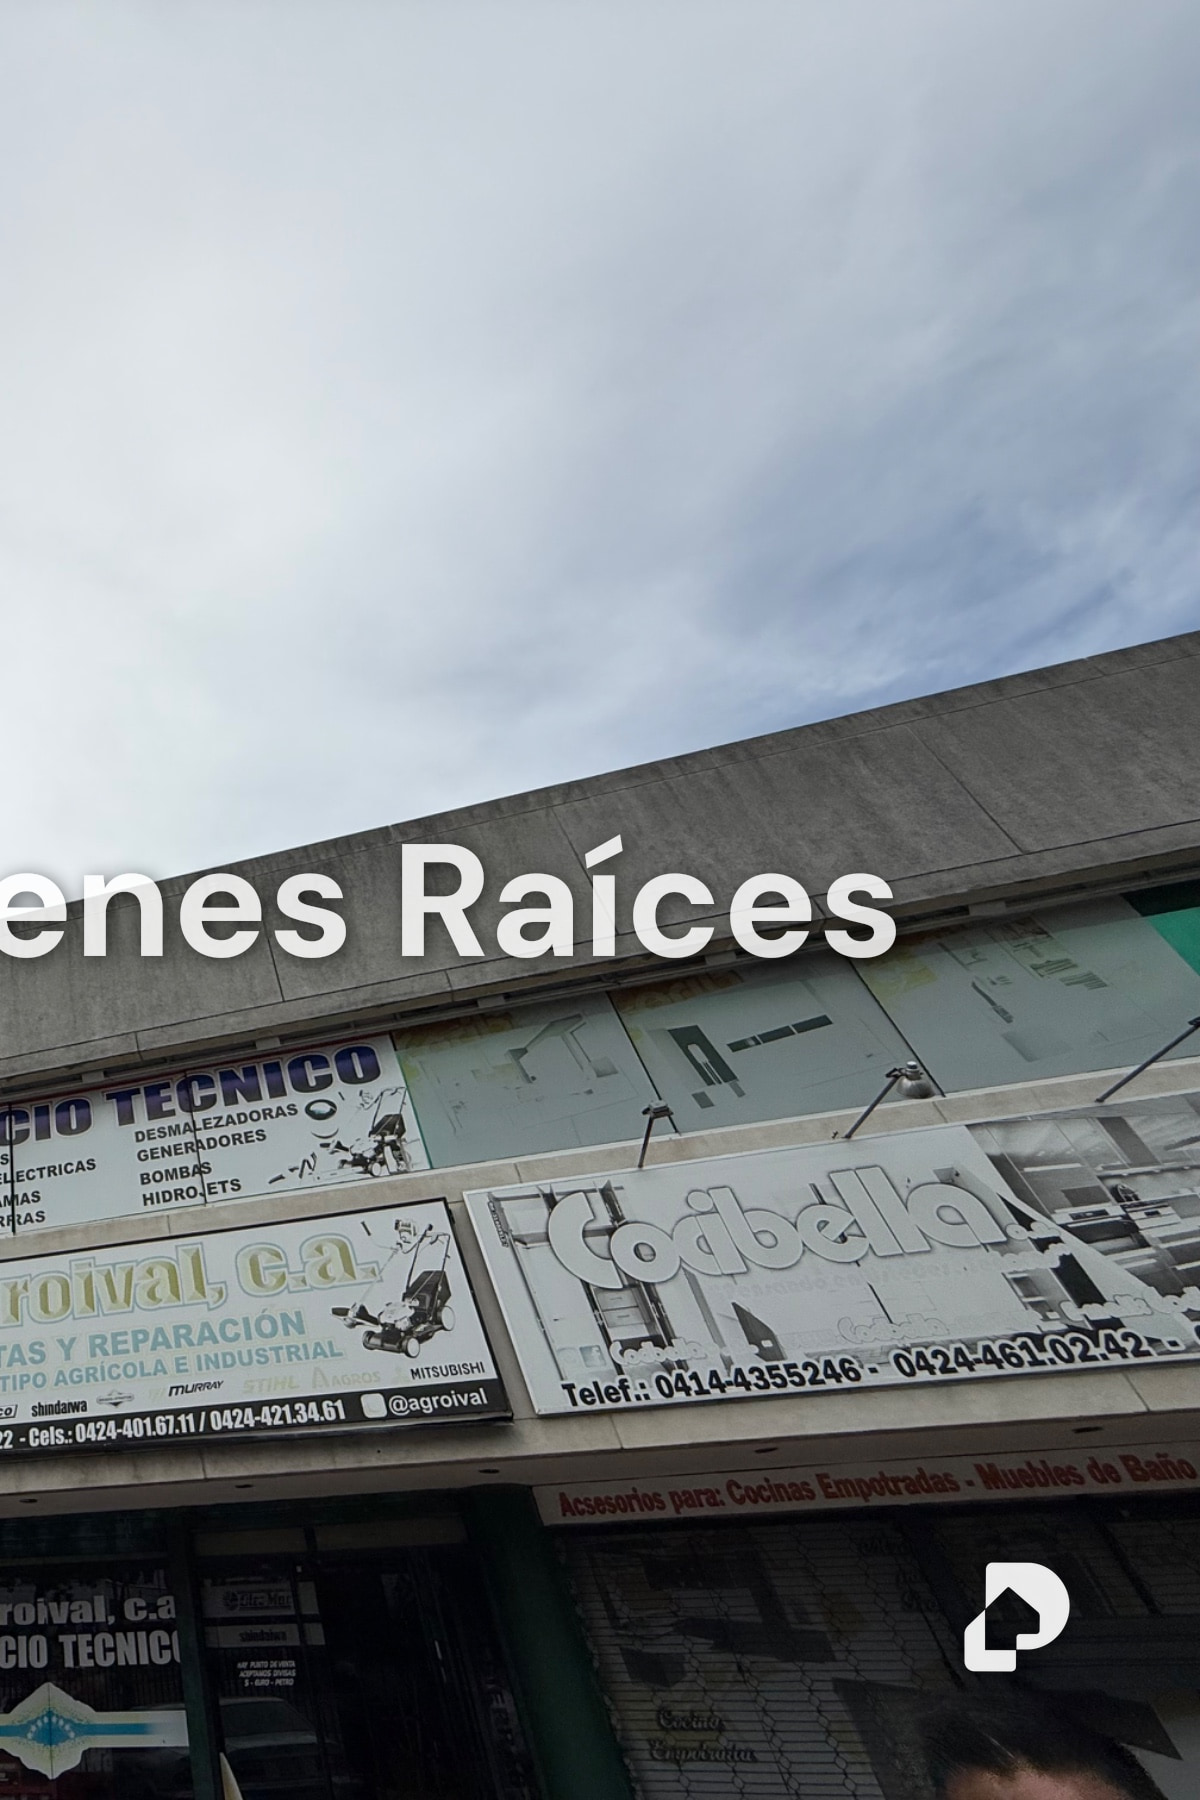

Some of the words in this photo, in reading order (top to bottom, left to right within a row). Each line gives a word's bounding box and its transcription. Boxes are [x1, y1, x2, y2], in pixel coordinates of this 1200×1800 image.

[106, 1044, 382, 1128] TECNICO
[134, 1102, 299, 1144] DESMALEZADORAS
[136, 1128, 267, 1163] GENERADORES
[139, 1161, 213, 1186] BOMBAS
[547, 1165, 1008, 1290] Cocibella
[236, 1232, 383, 1298] c.a.
[55, 1336, 78, 1362] Y
[89, 1309, 306, 1359] REPARACIÓN
[0, 1370, 50, 1394] TIPO
[54, 1355, 168, 1388] AGRÍCOLA
[175, 1352, 189, 1374] E
[196, 1340, 344, 1372] INDUSTRIAL
[410, 1361, 486, 1381] MITSUBISHI
[655, 1357, 861, 1399] 0414-4355246
[894, 1331, 1153, 1379] 0424-461.02.42
[28, 1426, 73, 1448] Cels.:
[75, 1413, 195, 1443] 0424-401.67.11
[199, 1415, 206, 1433] /
[210, 1399, 346, 1431] 0424-421.34.61
[31, 1400, 88, 1418] shindaiwa
[389, 1387, 488, 1417] @agroival
[560, 1485, 665, 1518] Acsesorios
[667, 1486, 726, 1515] para:
[726, 1475, 816, 1507] Cocinas
[815, 1466, 961, 1502] Empotradas
[975, 1459, 1086, 1491] Muebles
[1086, 1456, 1123, 1485] de
[1118, 1452, 1198, 1483] Baño
[250, 1660, 269, 1669] PUNTO
